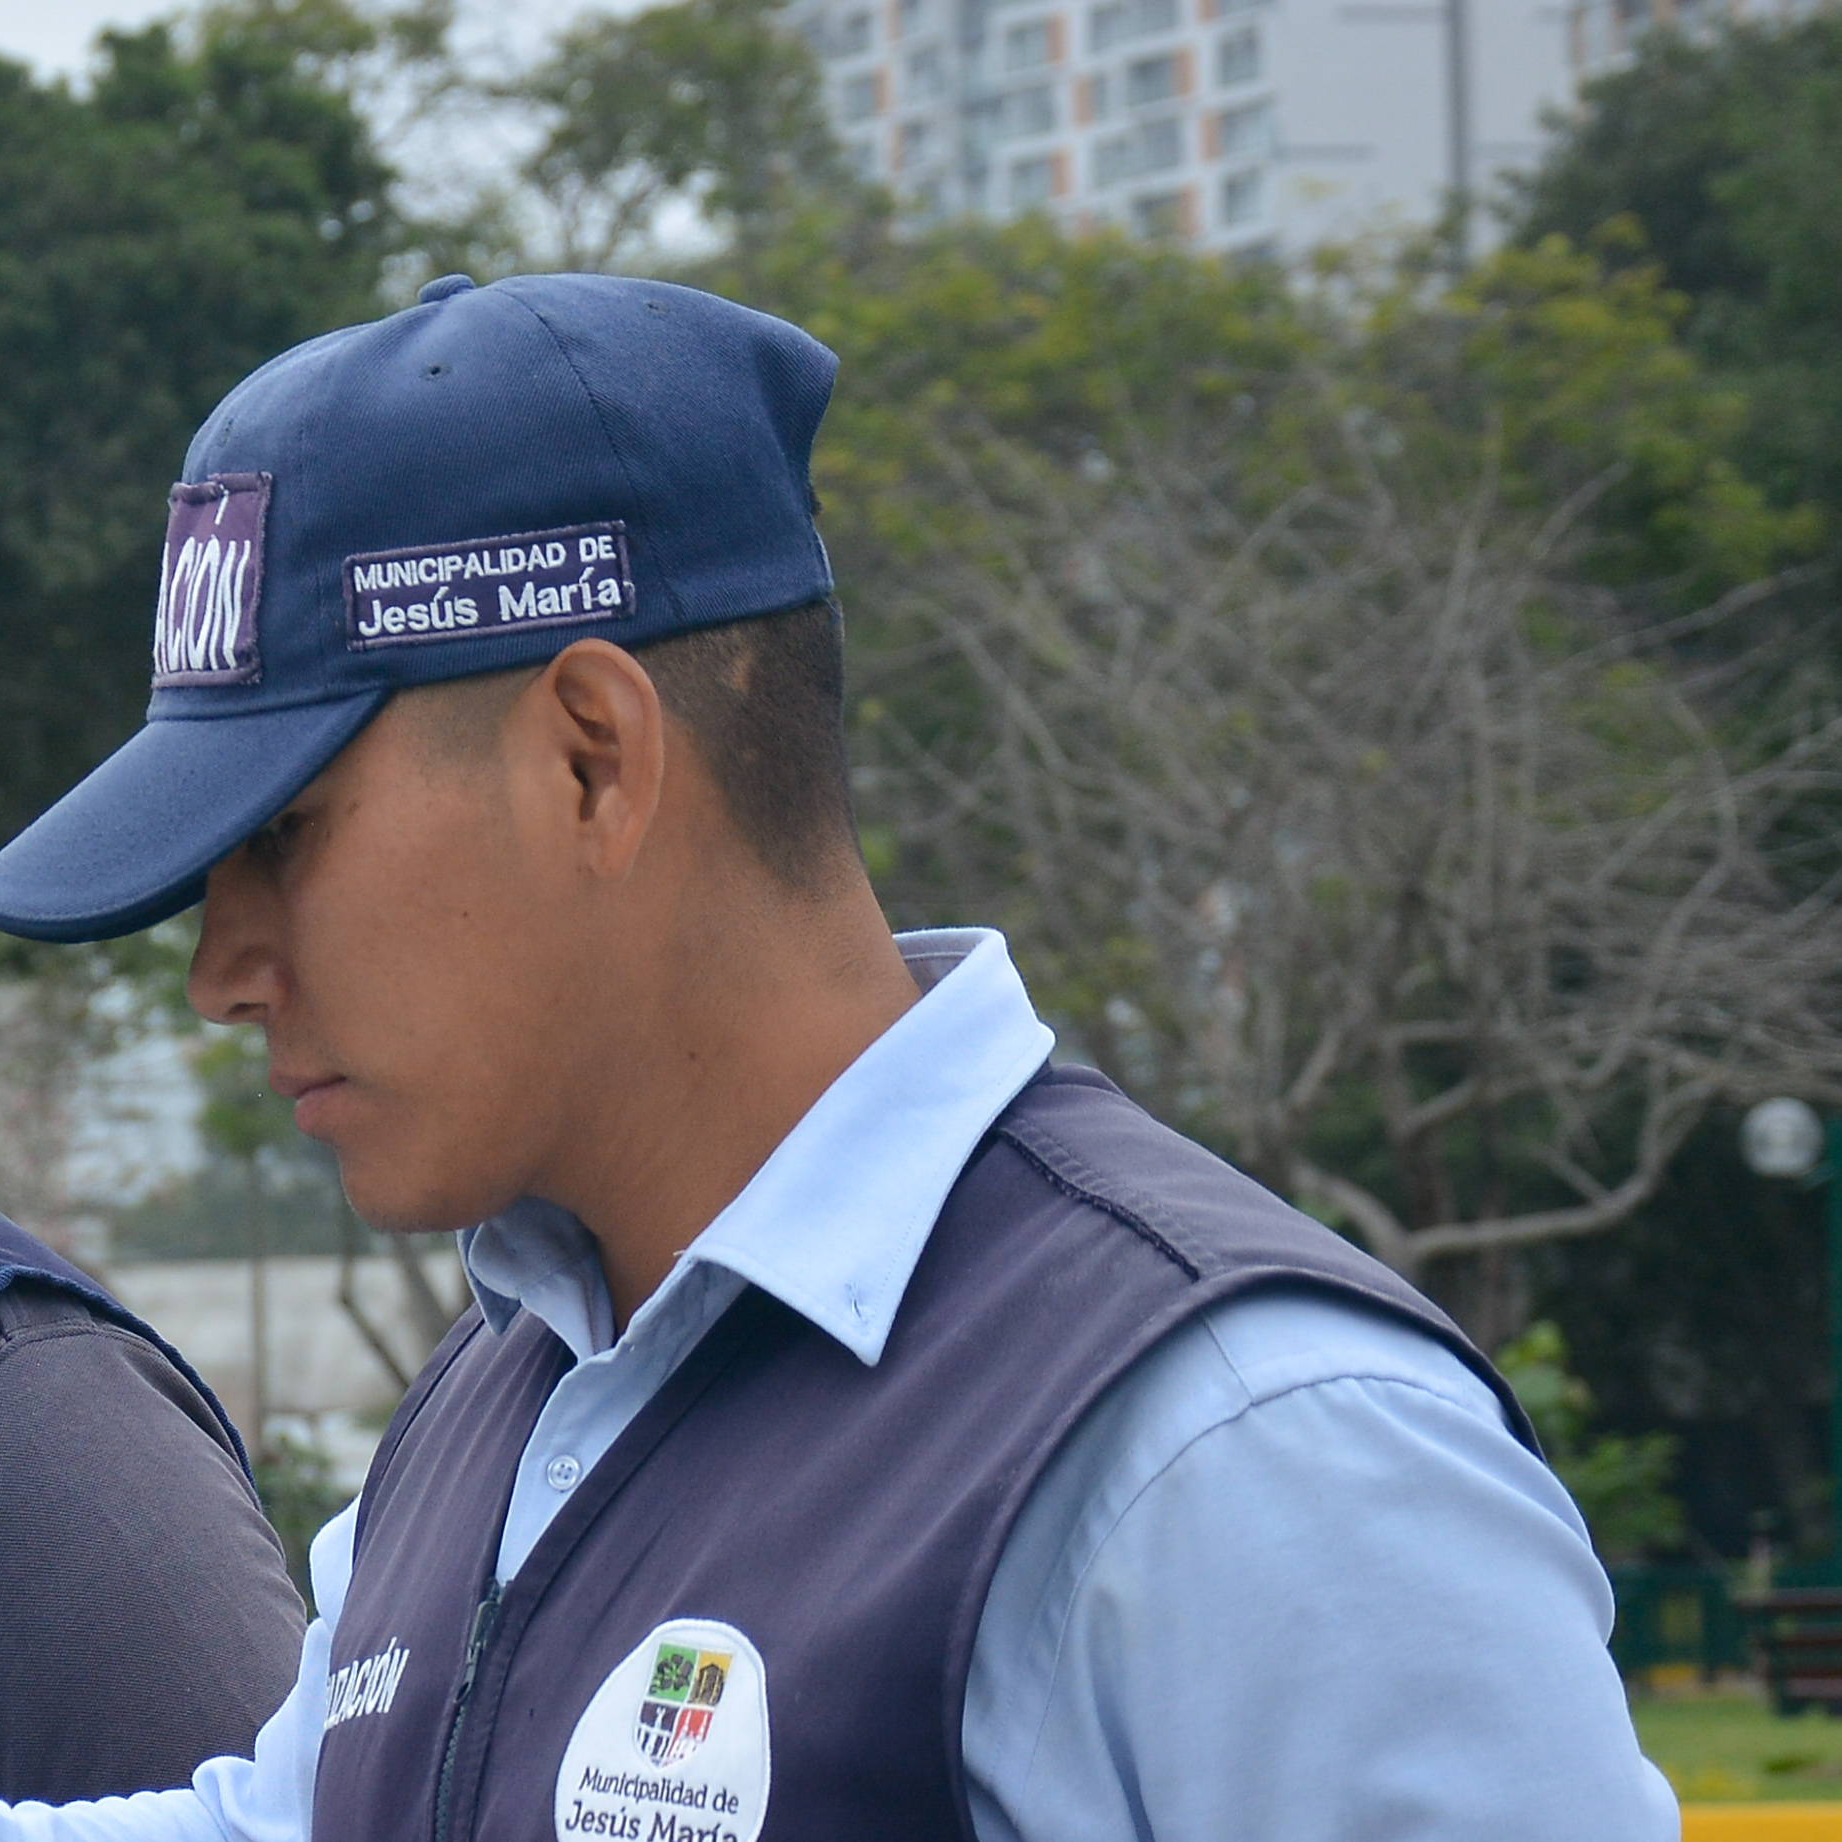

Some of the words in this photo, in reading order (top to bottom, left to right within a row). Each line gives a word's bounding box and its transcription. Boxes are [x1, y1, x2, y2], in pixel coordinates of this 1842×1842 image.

[153, 484, 252, 674] ACIÓN
[353, 541, 567, 592] MUNICIPALIDAD
[579, 535, 617, 562] DE
[358, 586, 479, 637] Jesús
[498, 566, 622, 622] María
[579, 1766, 709, 1809] Municipalidad
[711, 1787, 740, 1816] de
[565, 1800, 641, 1841] Jesús
